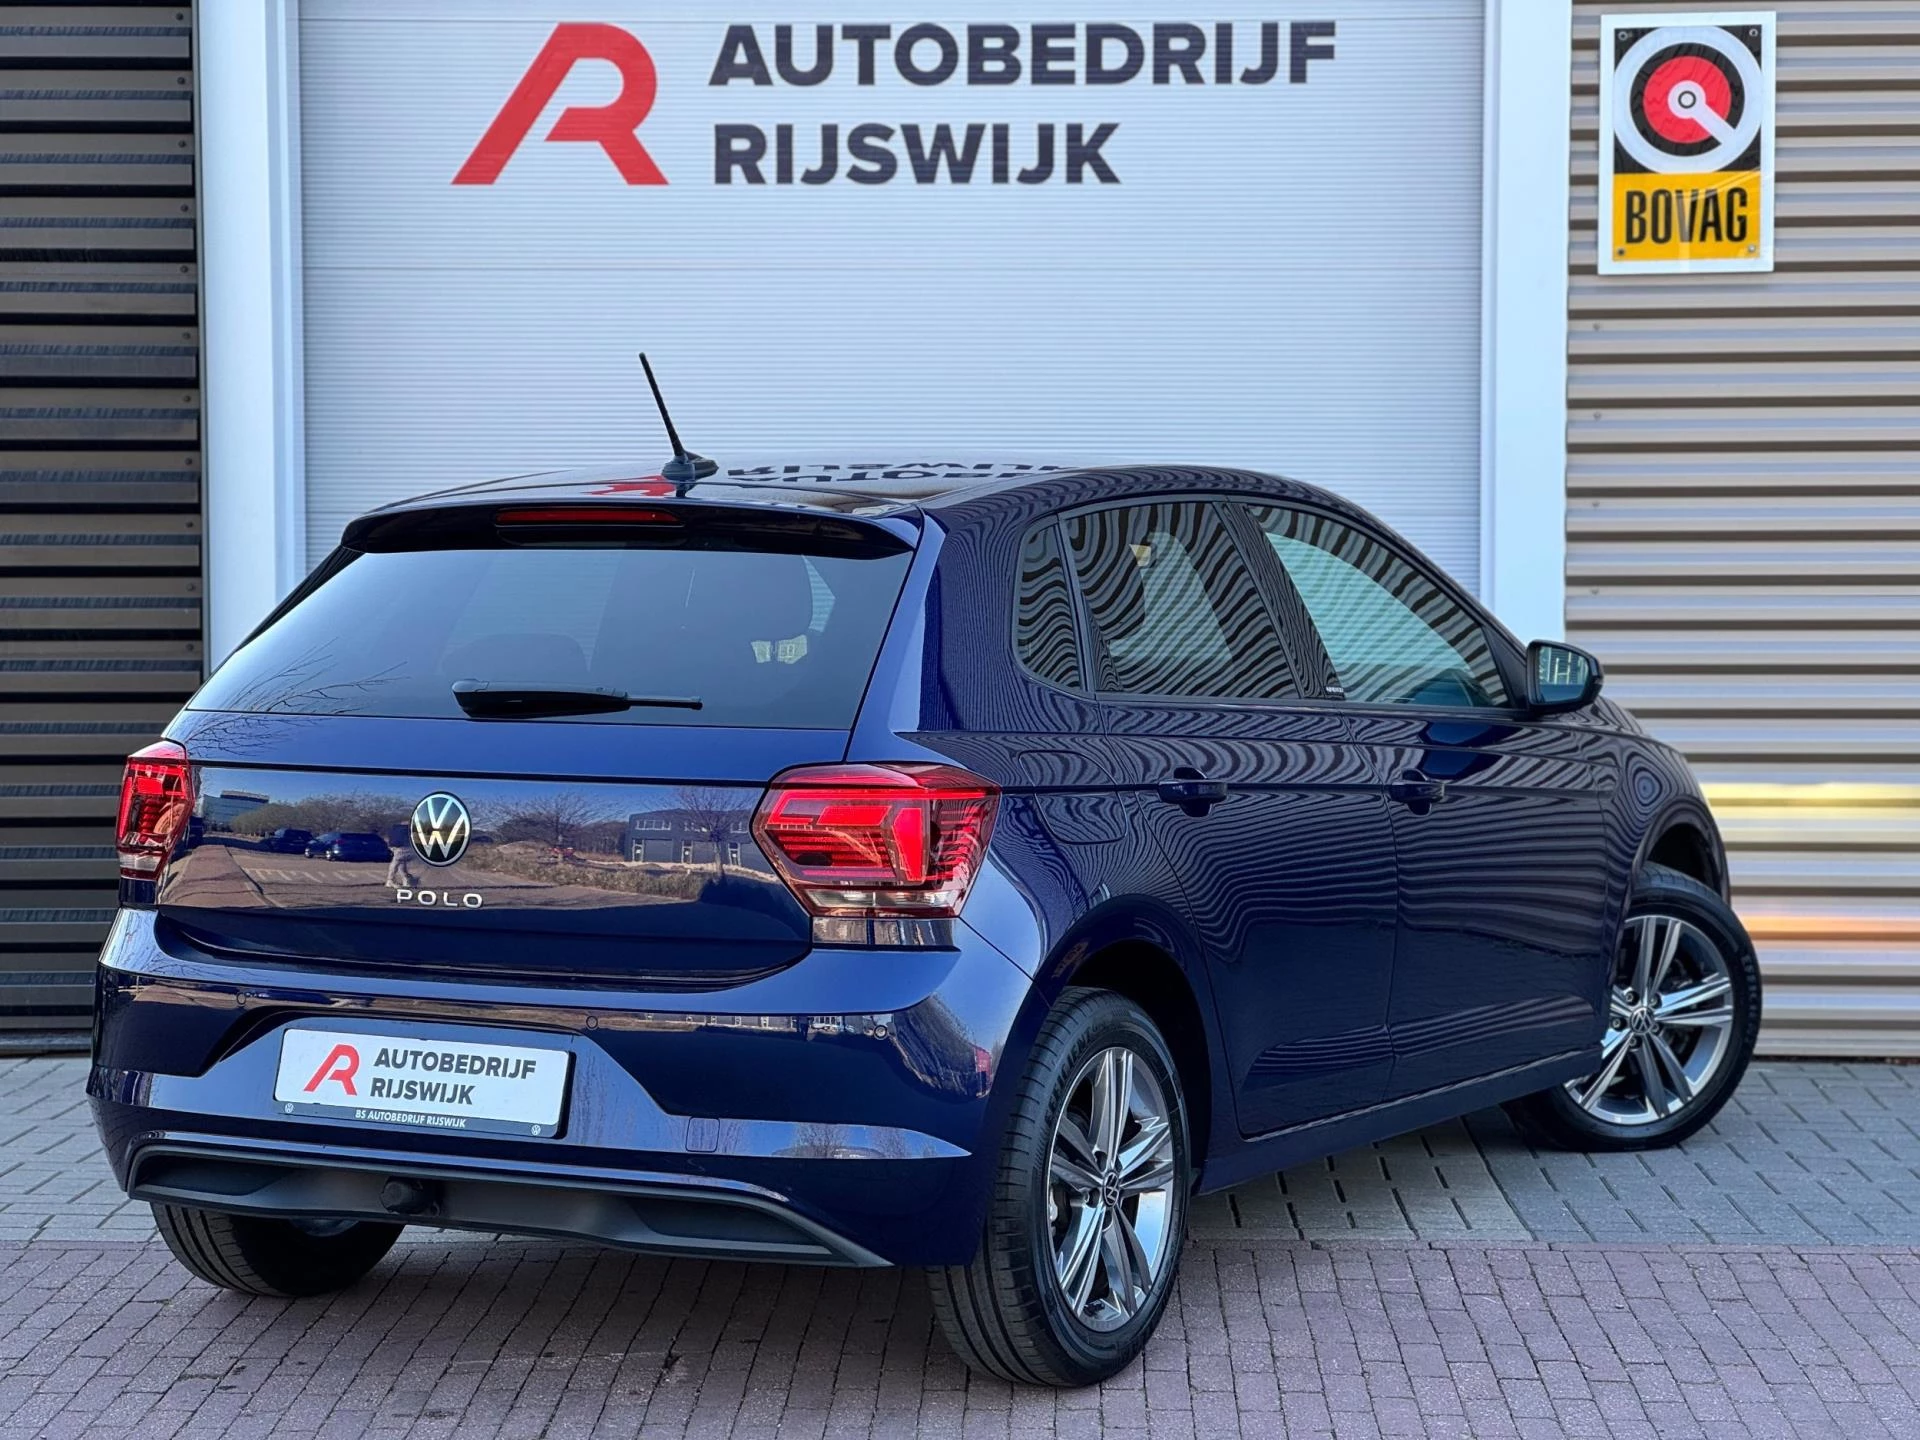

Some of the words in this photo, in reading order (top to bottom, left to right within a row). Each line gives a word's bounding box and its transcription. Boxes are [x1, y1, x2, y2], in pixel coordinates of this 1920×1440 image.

[708, 20, 1336, 87] AUTOBEDRIJF
[713, 122, 1121, 186] RIJSWIJK
[1625, 187, 1749, 245] BOVAG
[396, 888, 483, 909] POLO
[373, 1047, 537, 1080] AUTOBEDRIJF
[369, 1077, 476, 1106] RIJSWIJK
[355, 1109, 367, 1119] BS
[367, 1111, 426, 1125] AUTOBEDRIJF
[426, 1116, 466, 1129] RIJSWIJK
